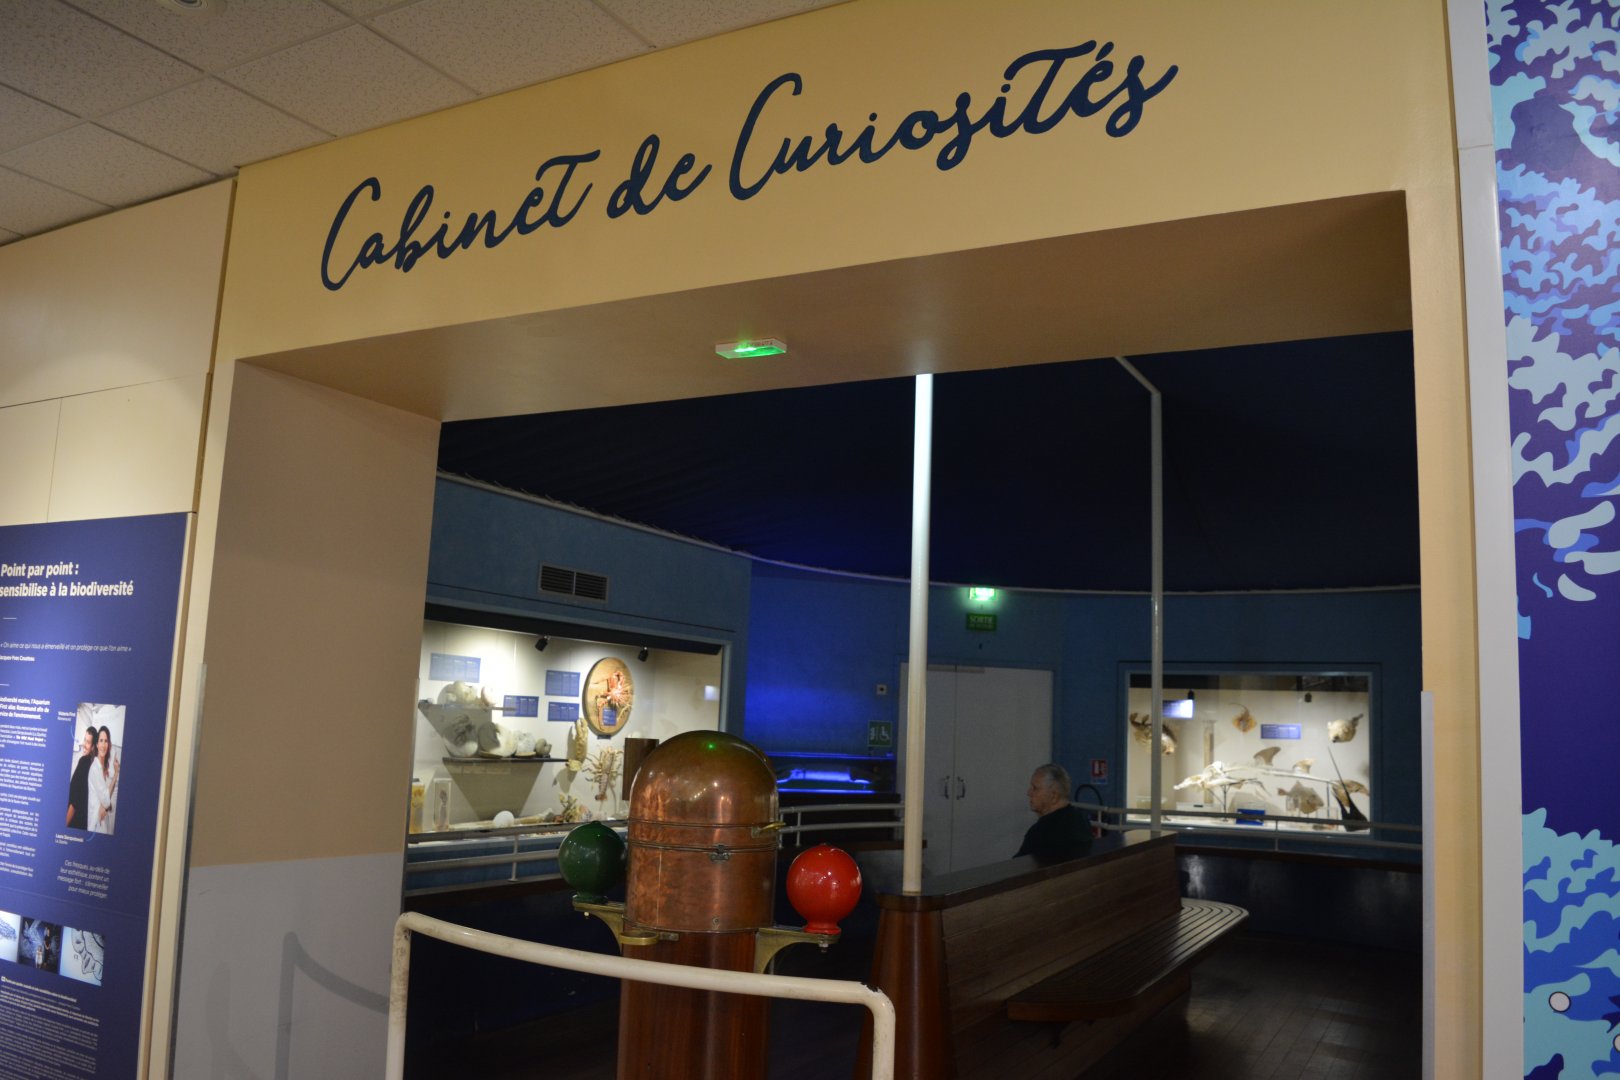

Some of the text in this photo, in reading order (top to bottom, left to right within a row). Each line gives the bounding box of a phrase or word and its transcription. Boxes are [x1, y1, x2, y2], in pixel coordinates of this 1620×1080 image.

[320, 40, 1179, 291] Cabinet de Curiosités
[1, 563, 26, 577] Point
[27, 564, 45, 578] par
[46, 561, 74, 578] point
[0, 580, 134, 597] sensibilise à la biodiversité
